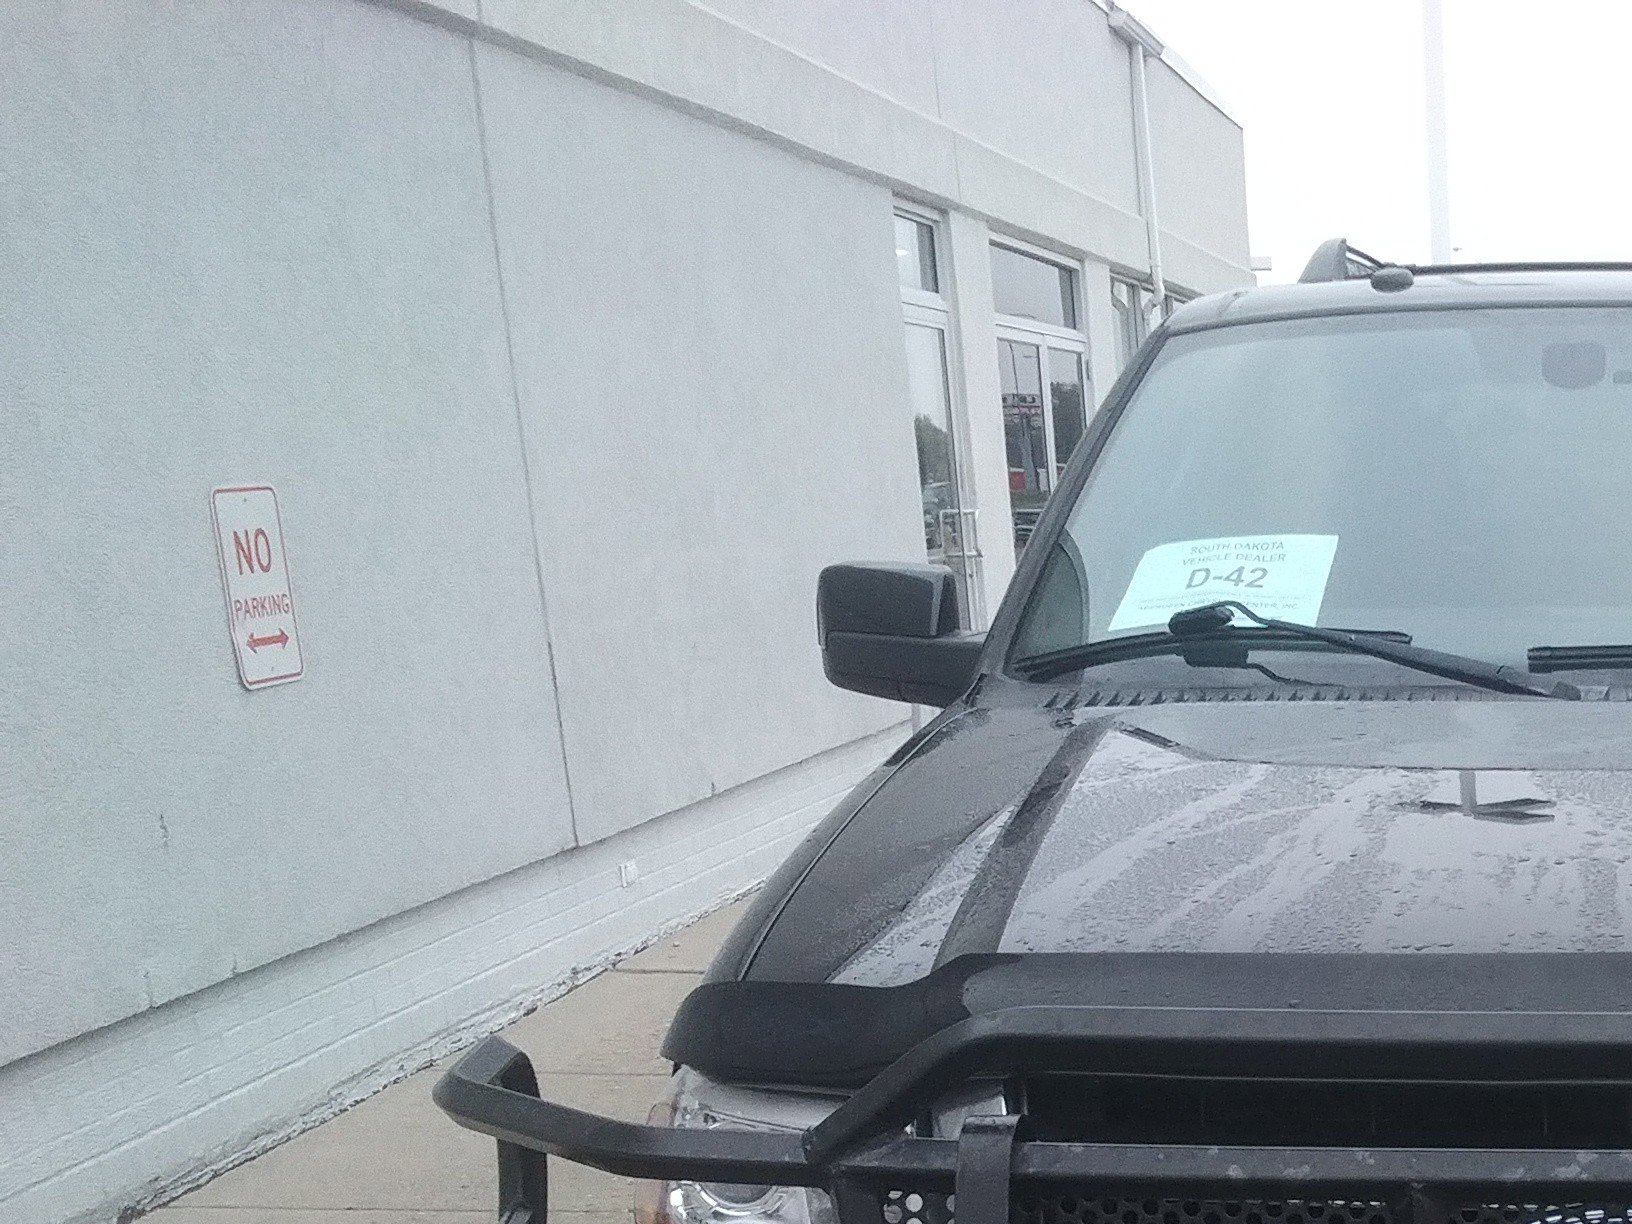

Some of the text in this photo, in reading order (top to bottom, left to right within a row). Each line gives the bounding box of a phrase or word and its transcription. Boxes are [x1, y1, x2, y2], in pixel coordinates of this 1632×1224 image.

[233, 528, 271, 575] NO
[1182, 553, 1286, 566] VEHICLE DEALER
[1190, 541, 1284, 555] SOUTH DAKOTA
[1185, 565, 1269, 590] D-42
[235, 594, 291, 620] PARKING
